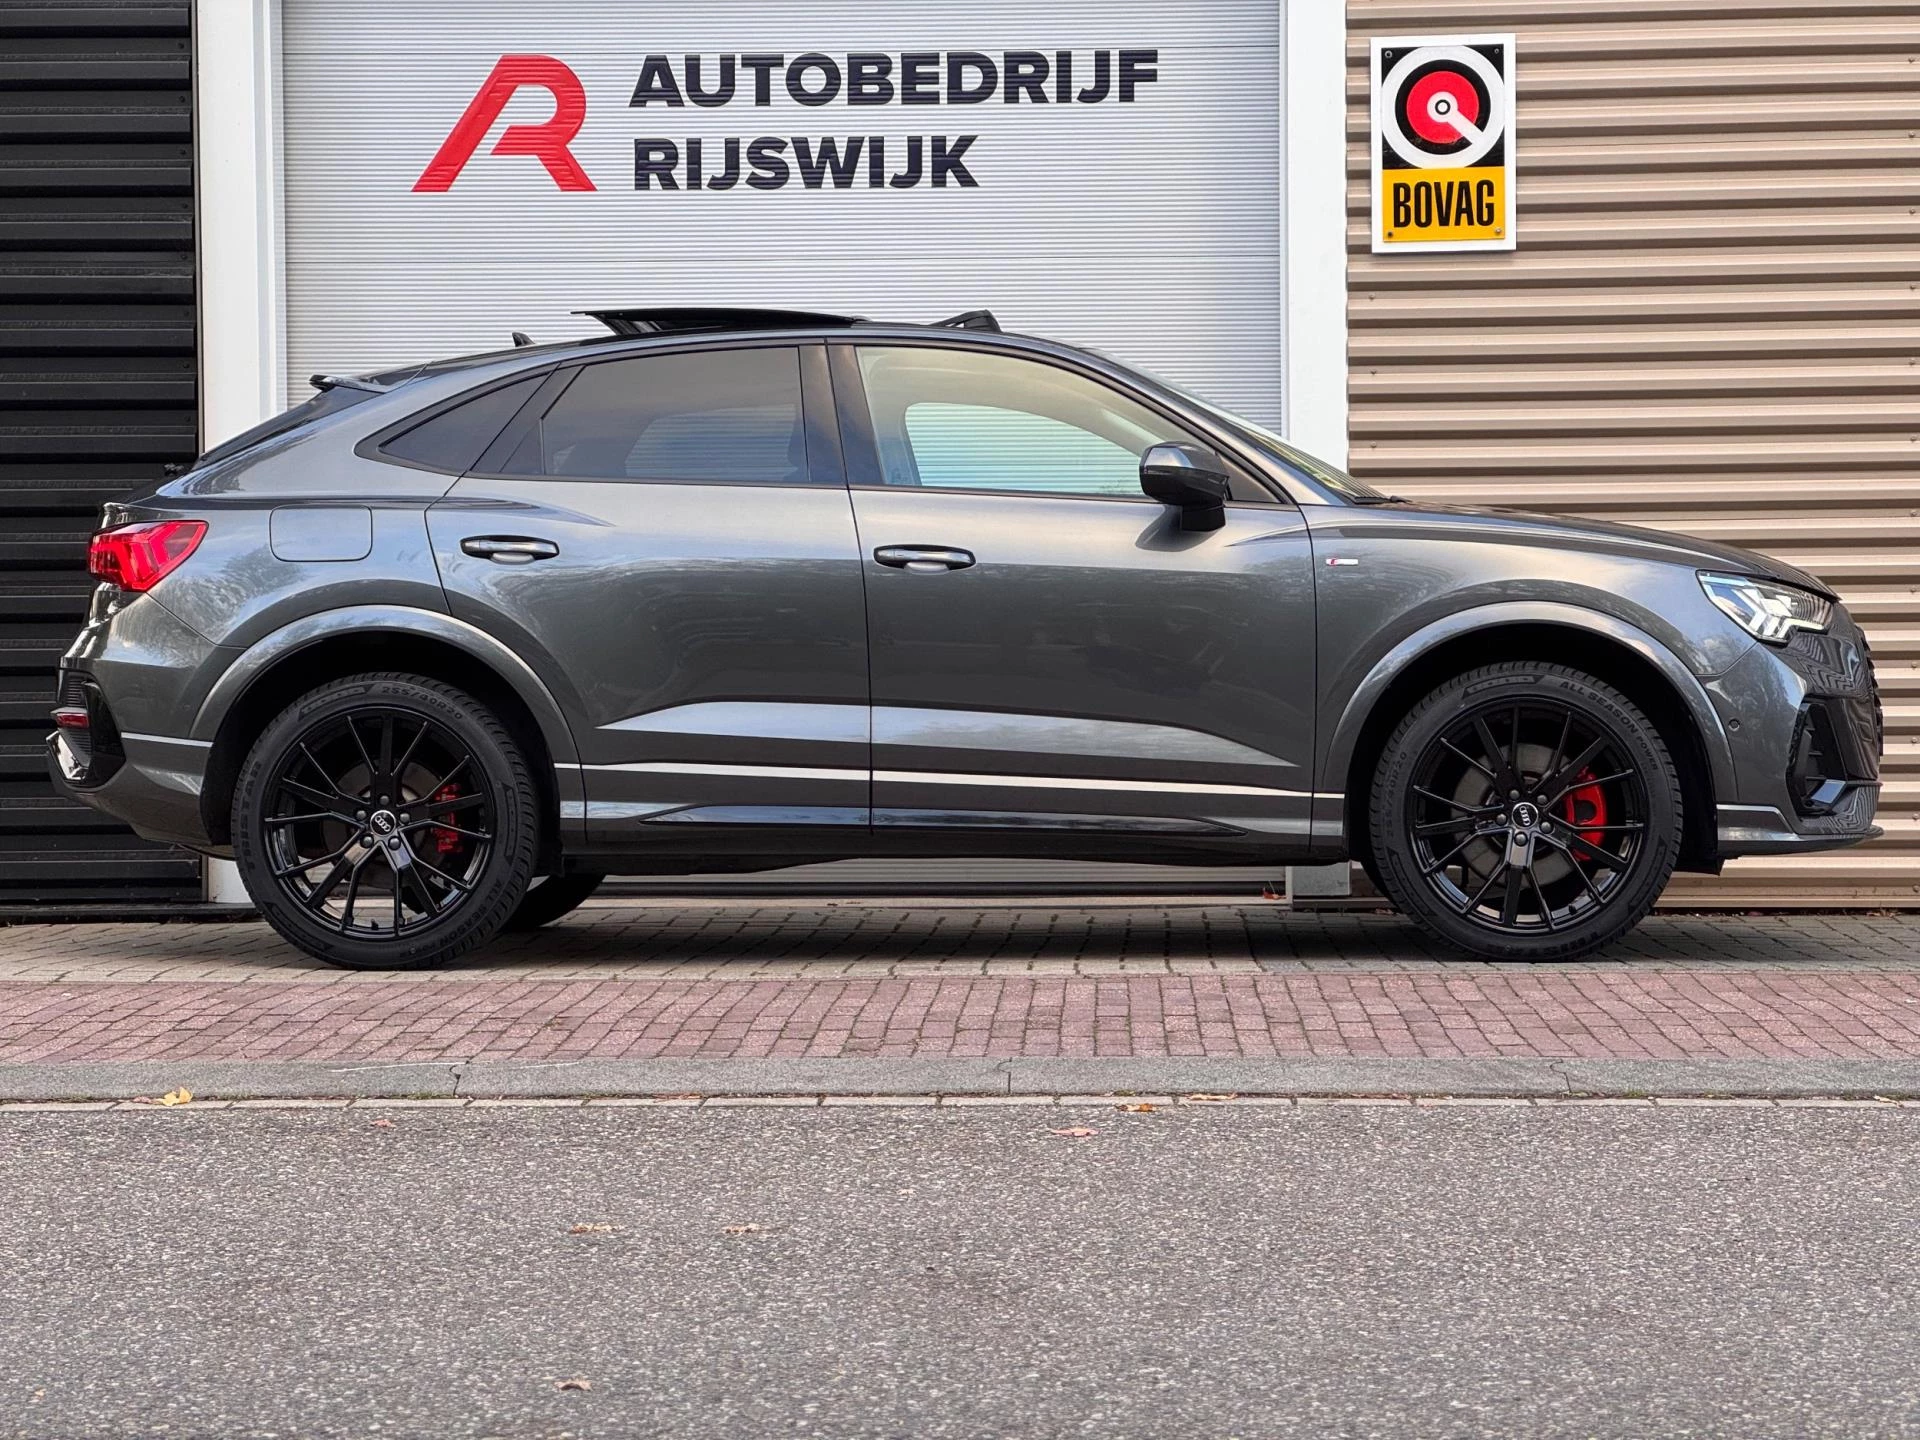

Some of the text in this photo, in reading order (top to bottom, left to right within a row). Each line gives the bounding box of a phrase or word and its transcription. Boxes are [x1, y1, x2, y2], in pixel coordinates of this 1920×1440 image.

[629, 50, 1158, 108] AUTOBEDRIJF
[634, 135, 980, 191] RIJSWIJK
[1393, 179, 1495, 228] BOVAG
[381, 686, 463, 720] 255/40R20
[1559, 681, 1585, 697] ALL
[1587, 691, 1639, 738] SEASON
